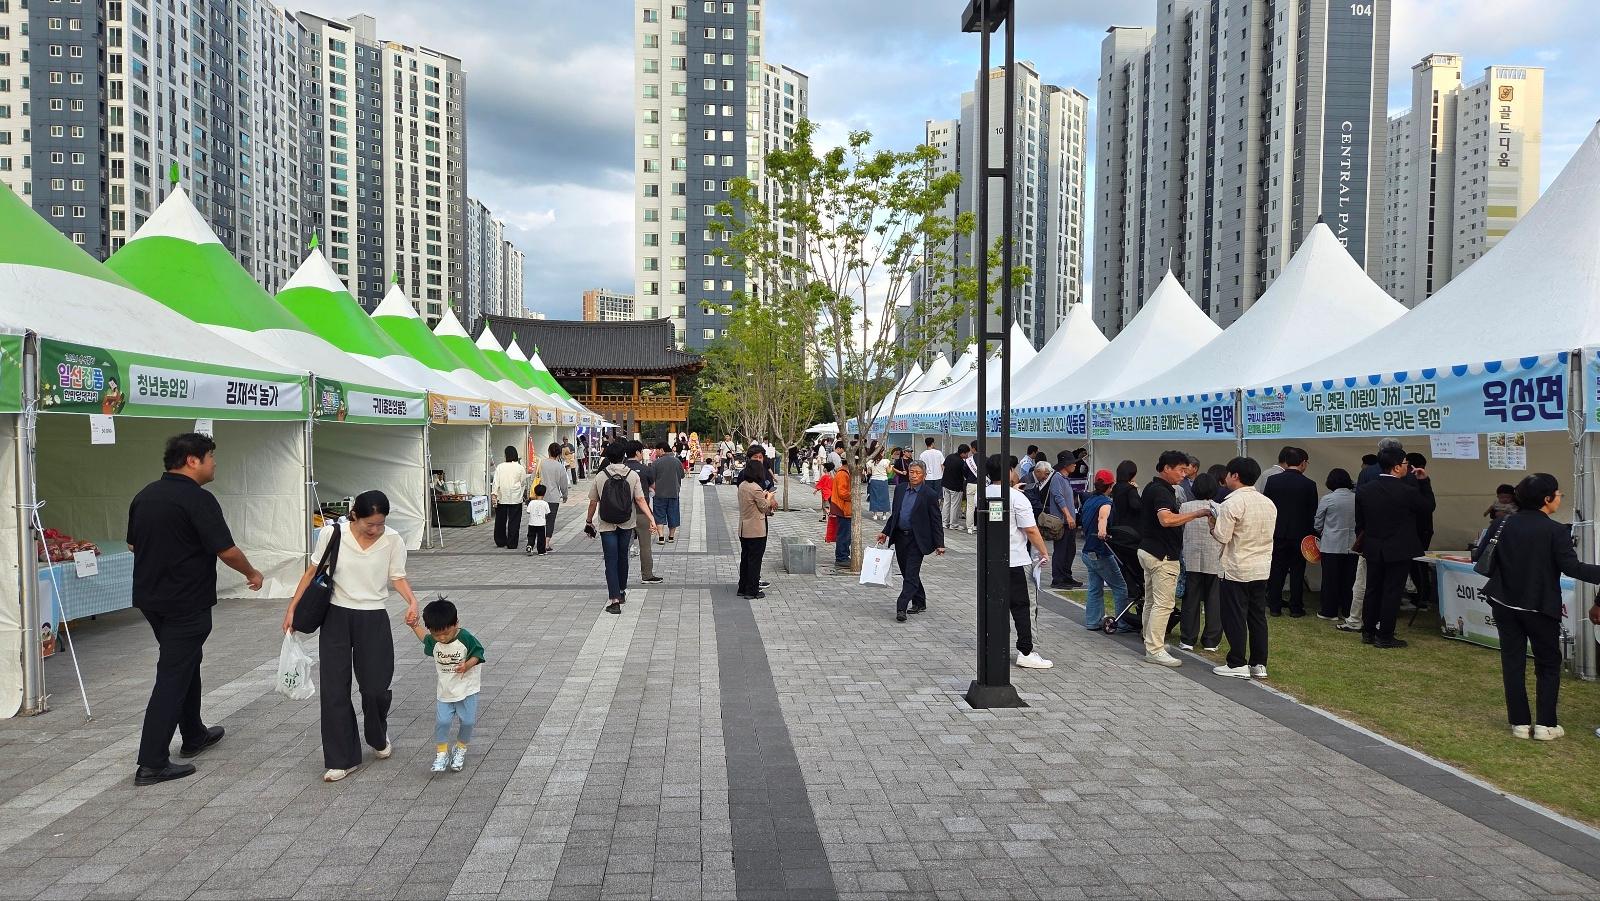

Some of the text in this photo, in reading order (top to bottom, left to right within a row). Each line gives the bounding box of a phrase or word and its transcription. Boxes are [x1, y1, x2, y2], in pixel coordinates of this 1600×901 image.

[1350, 4, 1371, 16] 104
[1498, 105, 1512, 167] 골드디움
[1339, 121, 1352, 207] CENTRAL
[57, 362, 104, 391] 일선정품
[137, 374, 189, 399] 청년농업인
[226, 381, 279, 407] 김재석 농가
[1350, 388, 1378, 409] 사람의
[1380, 386, 1401, 407] 가치
[1403, 383, 1436, 405] 그리고
[1483, 375, 1564, 422] 옥성면
[1066, 413, 1086, 434] 산동읍
[1160, 413, 1185, 431] 함께하는
[1185, 411, 1200, 430] 농촌
[1201, 405, 1234, 433] 무을면
[1316, 414, 1342, 433] 새롭게
[1344, 411, 1381, 432] 도약하는
[1383, 410, 1415, 431] 우리는
[1456, 585, 1475, 600] 신이
